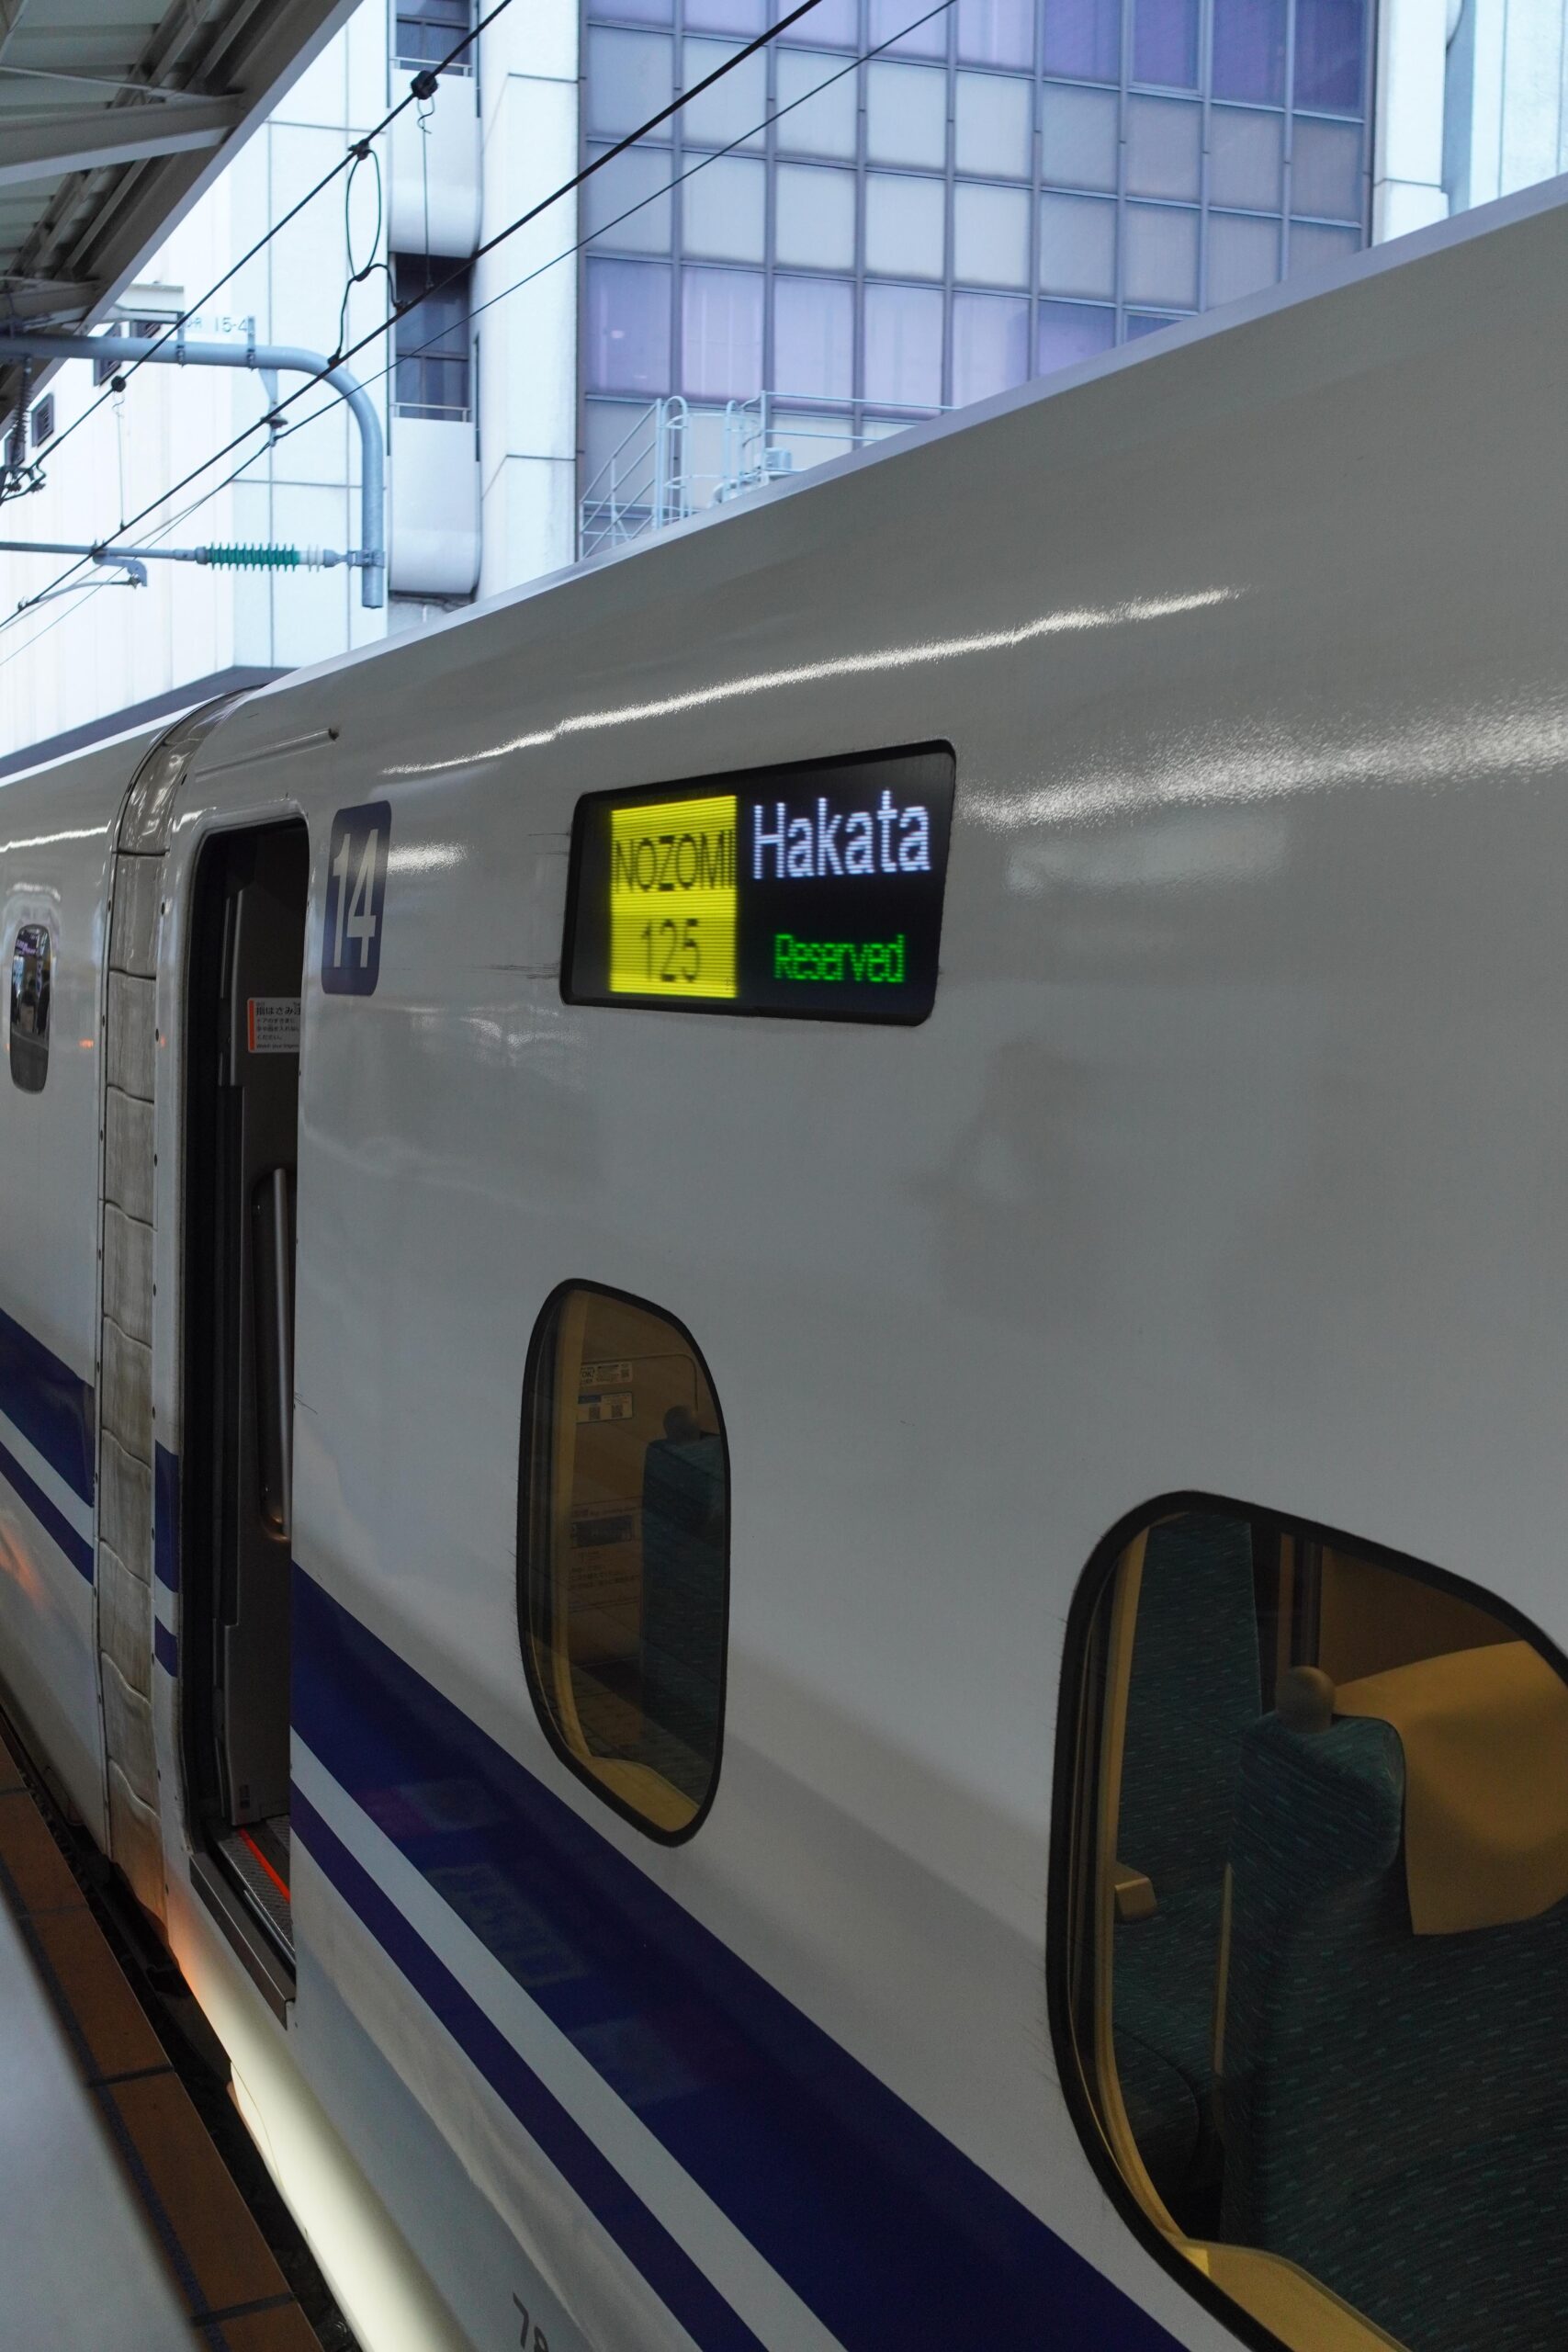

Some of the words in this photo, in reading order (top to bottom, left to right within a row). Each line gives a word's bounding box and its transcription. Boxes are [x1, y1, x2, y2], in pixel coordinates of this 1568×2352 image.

[612, 829, 736, 893] NOZOMI
[753, 789, 931, 878] Hakata
[333, 829, 378, 968] 14
[640, 918, 701, 984] 125
[773, 933, 906, 983] Reserved
